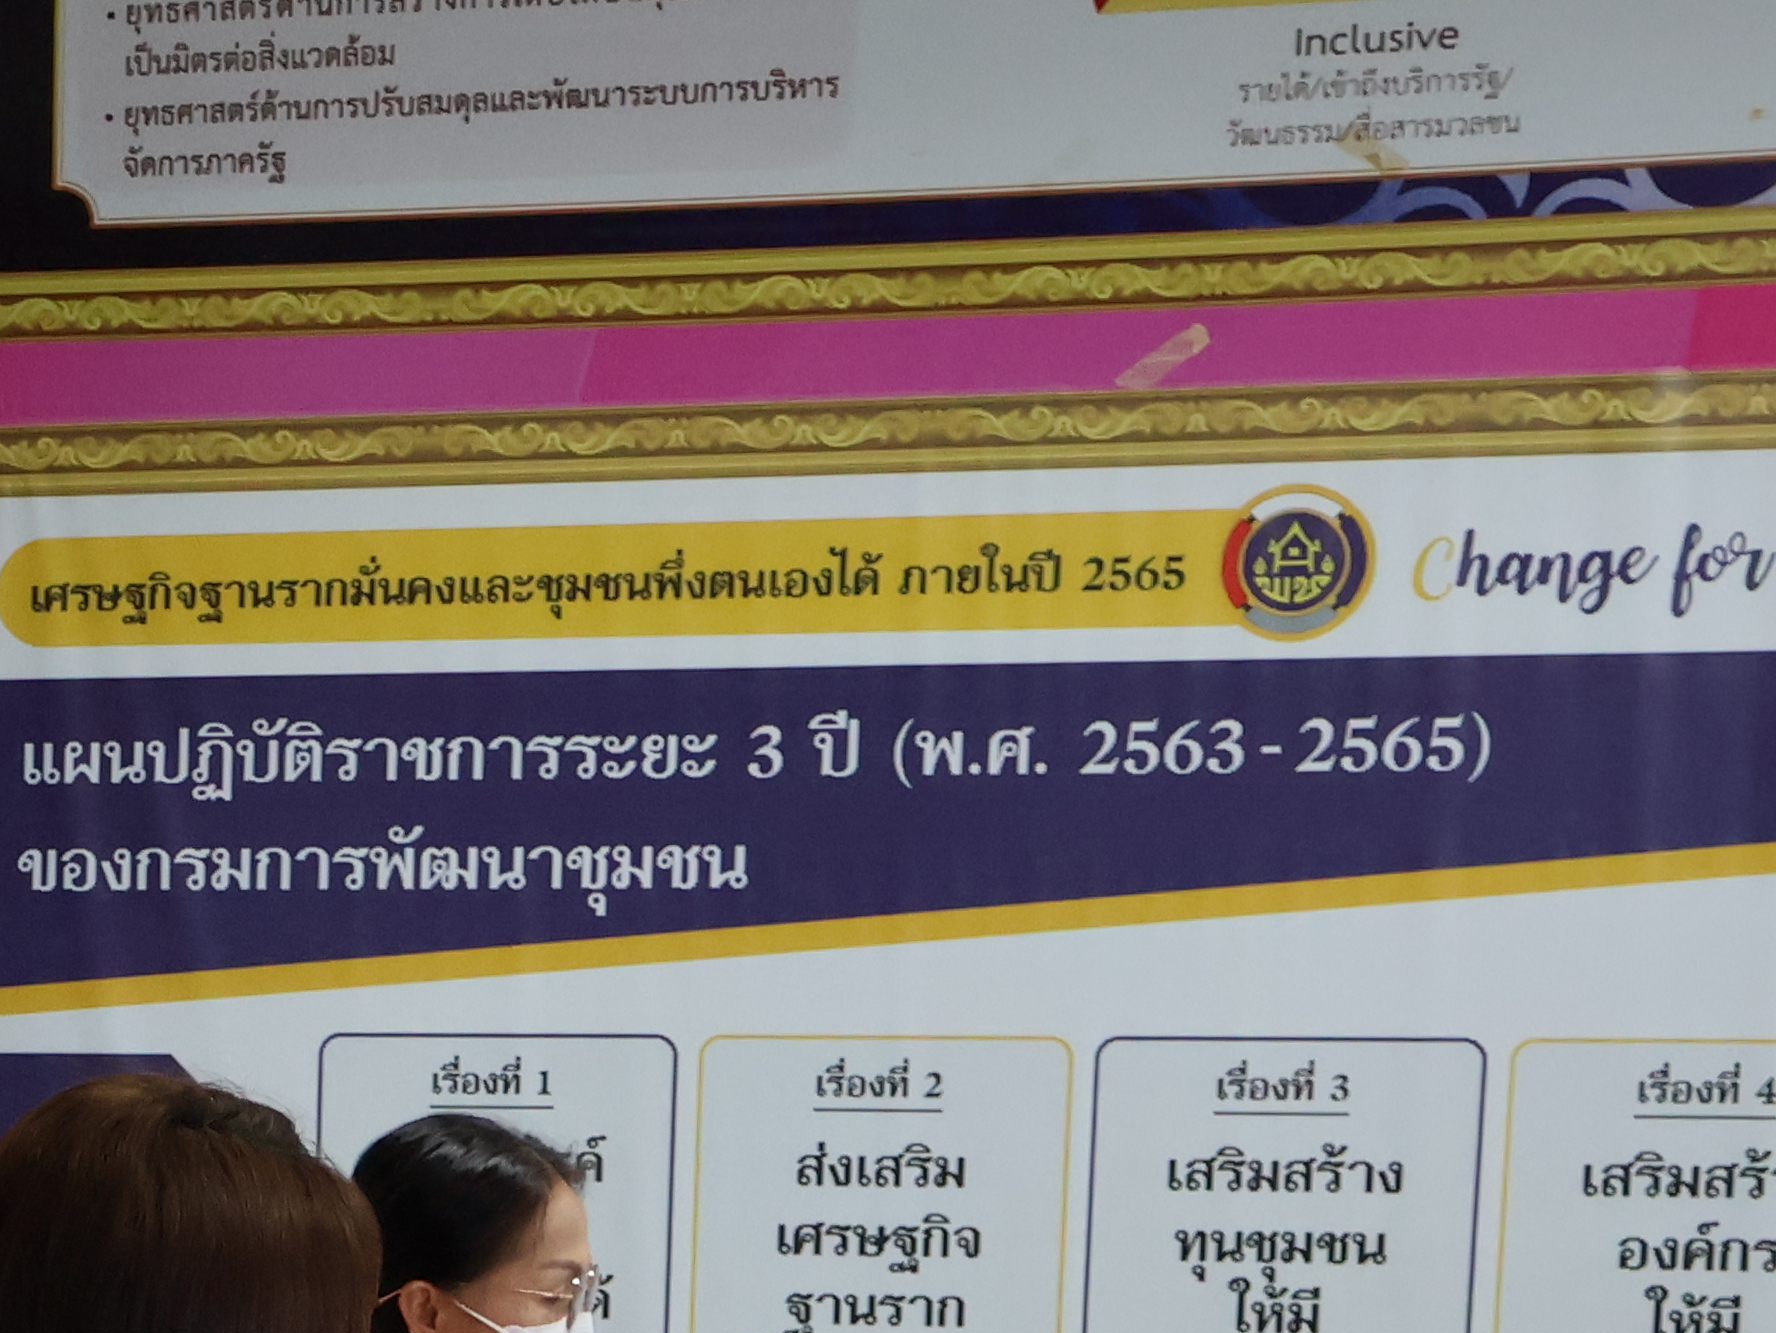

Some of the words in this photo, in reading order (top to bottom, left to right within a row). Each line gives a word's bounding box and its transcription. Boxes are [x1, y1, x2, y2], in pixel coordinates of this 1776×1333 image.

[1295, 21, 1460, 57] Inclusive
[30, 546, 882, 624] เศรษฐกิจฐานรากมั่นคงและชุมชนพึ่งตนเองได้
[898, 543, 1062, 594] ภายในปี
[1082, 555, 1186, 593] 2565
[1412, 528, 1660, 615] Change
[1670, 523, 1776, 618] for
[22, 718, 718, 800] แผนปฏิบัติราชการระยะ
[747, 725, 785, 779] 3
[809, 709, 861, 778] ปี
[893, 722, 1048, 788] (พ.ศ.
[1079, 719, 1245, 776] 2563
[1294, 712, 1493, 783] 2565)
[17, 826, 749, 917] ของกรมการพัฒนาชุมชน
[432, 1056, 522, 1096] เรื่องที่
[539, 1071, 552, 1096] 1
[815, 1058, 911, 1099] เรื่องที่
[924, 1071, 944, 1099] 2
[1216, 1059, 1316, 1103] เรื่องที่
[1331, 1074, 1350, 1103] 3
[1637, 1062, 1740, 1106] เรื่องที่
[795, 1140, 967, 1190] ส่งเสริม
[1167, 1143, 1404, 1195] เสริมสร้าง
[777, 1214, 982, 1274] เศรษฐกิจ
[1174, 1227, 1389, 1283] ทุนชุมชน
